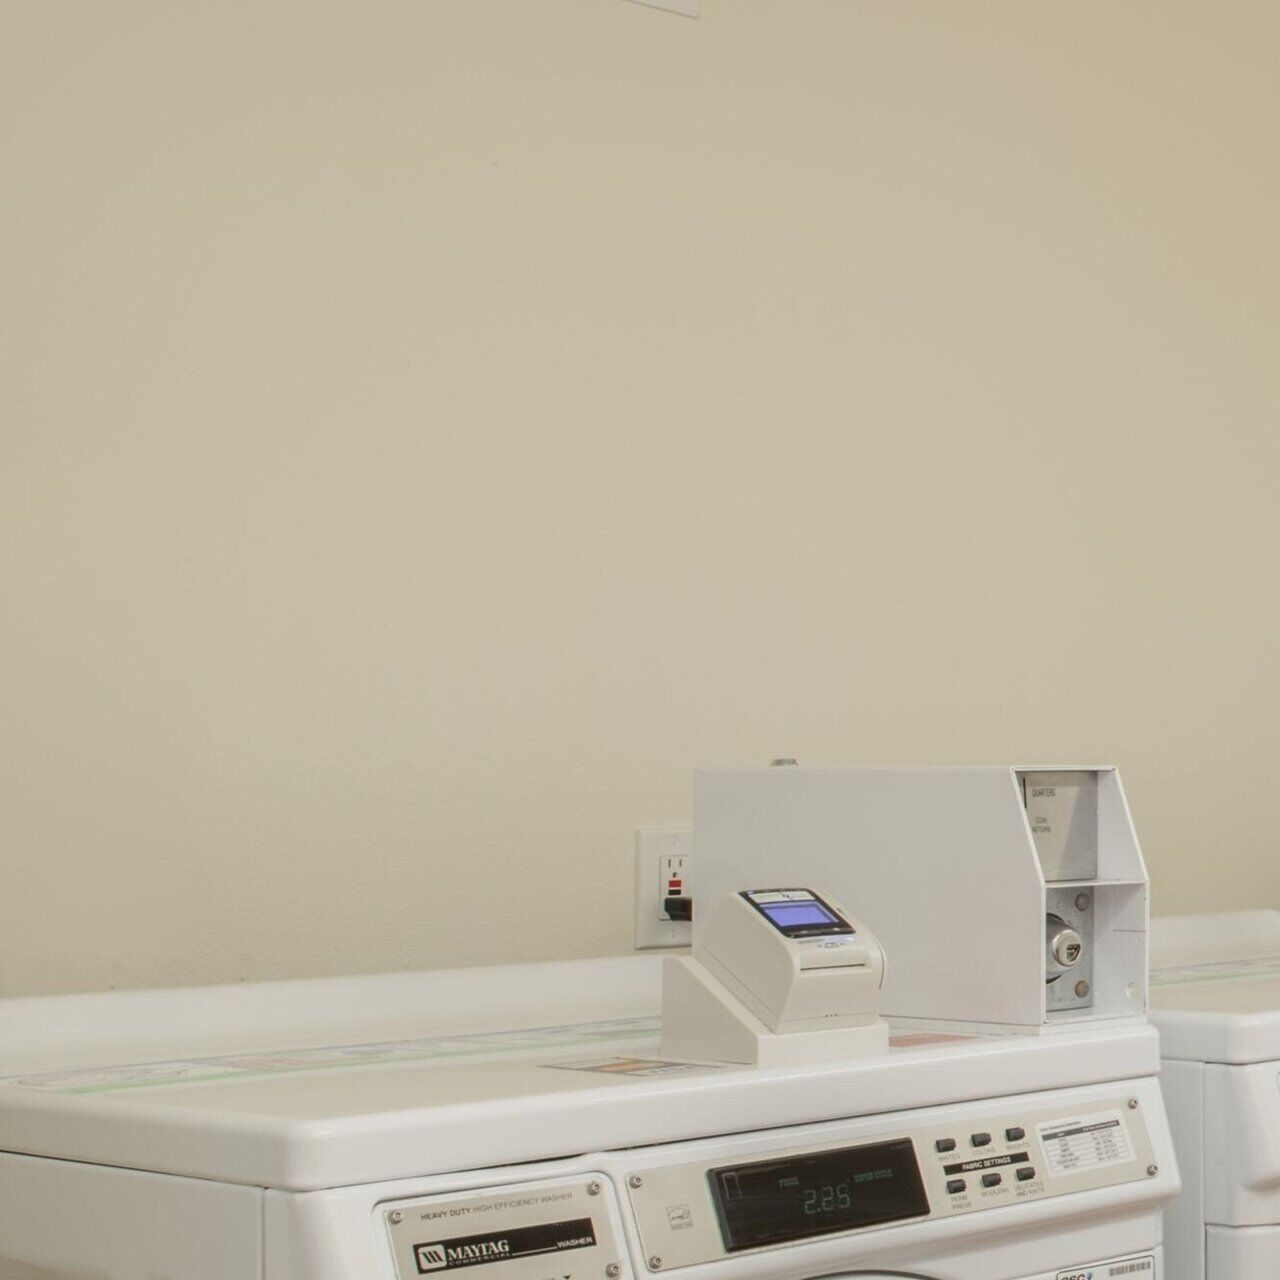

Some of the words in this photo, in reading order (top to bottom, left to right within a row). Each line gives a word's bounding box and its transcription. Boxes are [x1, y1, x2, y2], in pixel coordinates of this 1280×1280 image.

[1031, 787, 1056, 797] QUARTERS
[962, 1161, 983, 1170] FABRIC
[983, 1156, 1012, 1167] SETTINGS
[421, 1209, 447, 1220] HEAVY
[449, 1207, 471, 1217] DUTY
[473, 1205, 493, 1213] HIGH
[494, 1198, 539, 1211] EFFICIENCY
[541, 1192, 574, 1203] WASHER
[803, 1184, 851, 1215] 2.25
[447, 1240, 510, 1261] MAYTAG
[557, 1236, 594, 1248] WASHER
[448, 1252, 512, 1267] COMMERCIAL
